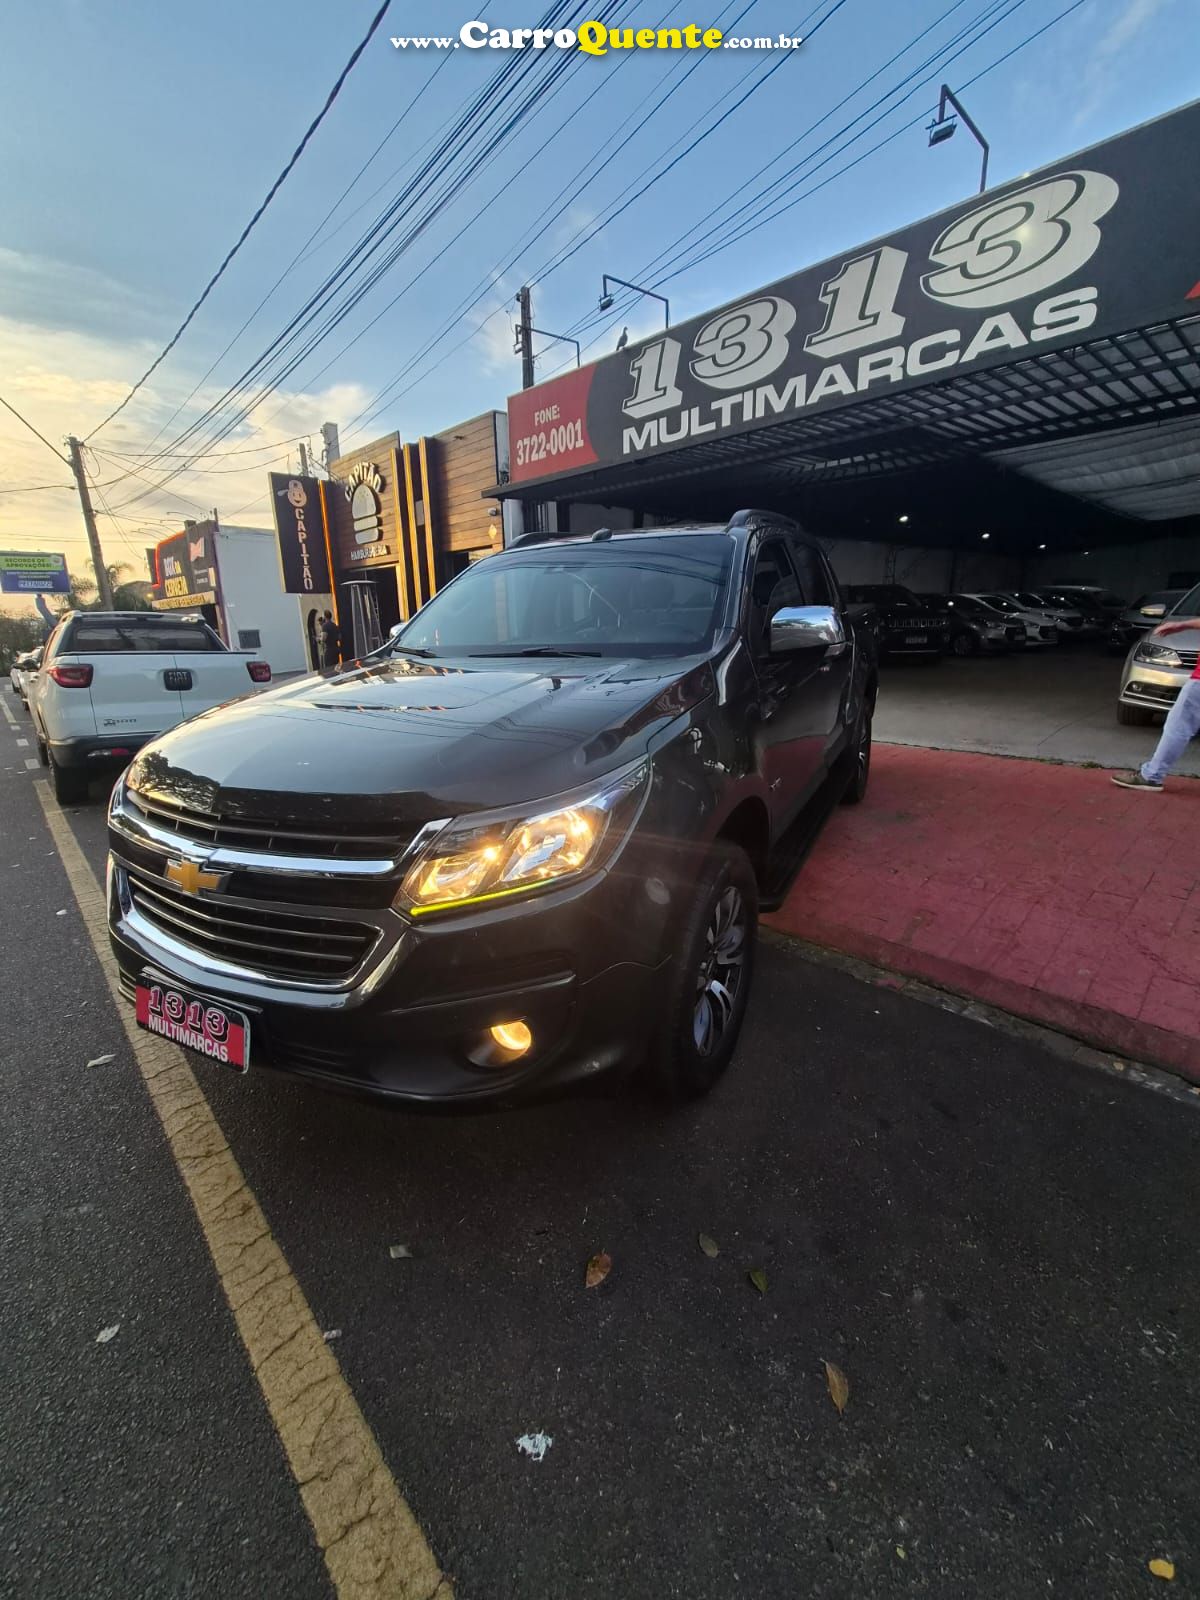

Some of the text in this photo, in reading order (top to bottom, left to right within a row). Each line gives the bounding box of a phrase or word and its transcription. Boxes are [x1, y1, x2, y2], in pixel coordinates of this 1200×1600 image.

[621, 169, 1120, 419] 1313
[621, 286, 1099, 455] MULTIMARCAS
[534, 404, 560, 427] FONE:
[516, 418, 584, 466] 3722-0001
[344, 462, 382, 502] CAPITÃO
[295, 508, 314, 590] CAPITÃO
[168, 671, 188, 681] FIAT
[148, 985, 230, 1044] 1313
[148, 1014, 229, 1063] MULTIMARCAS
